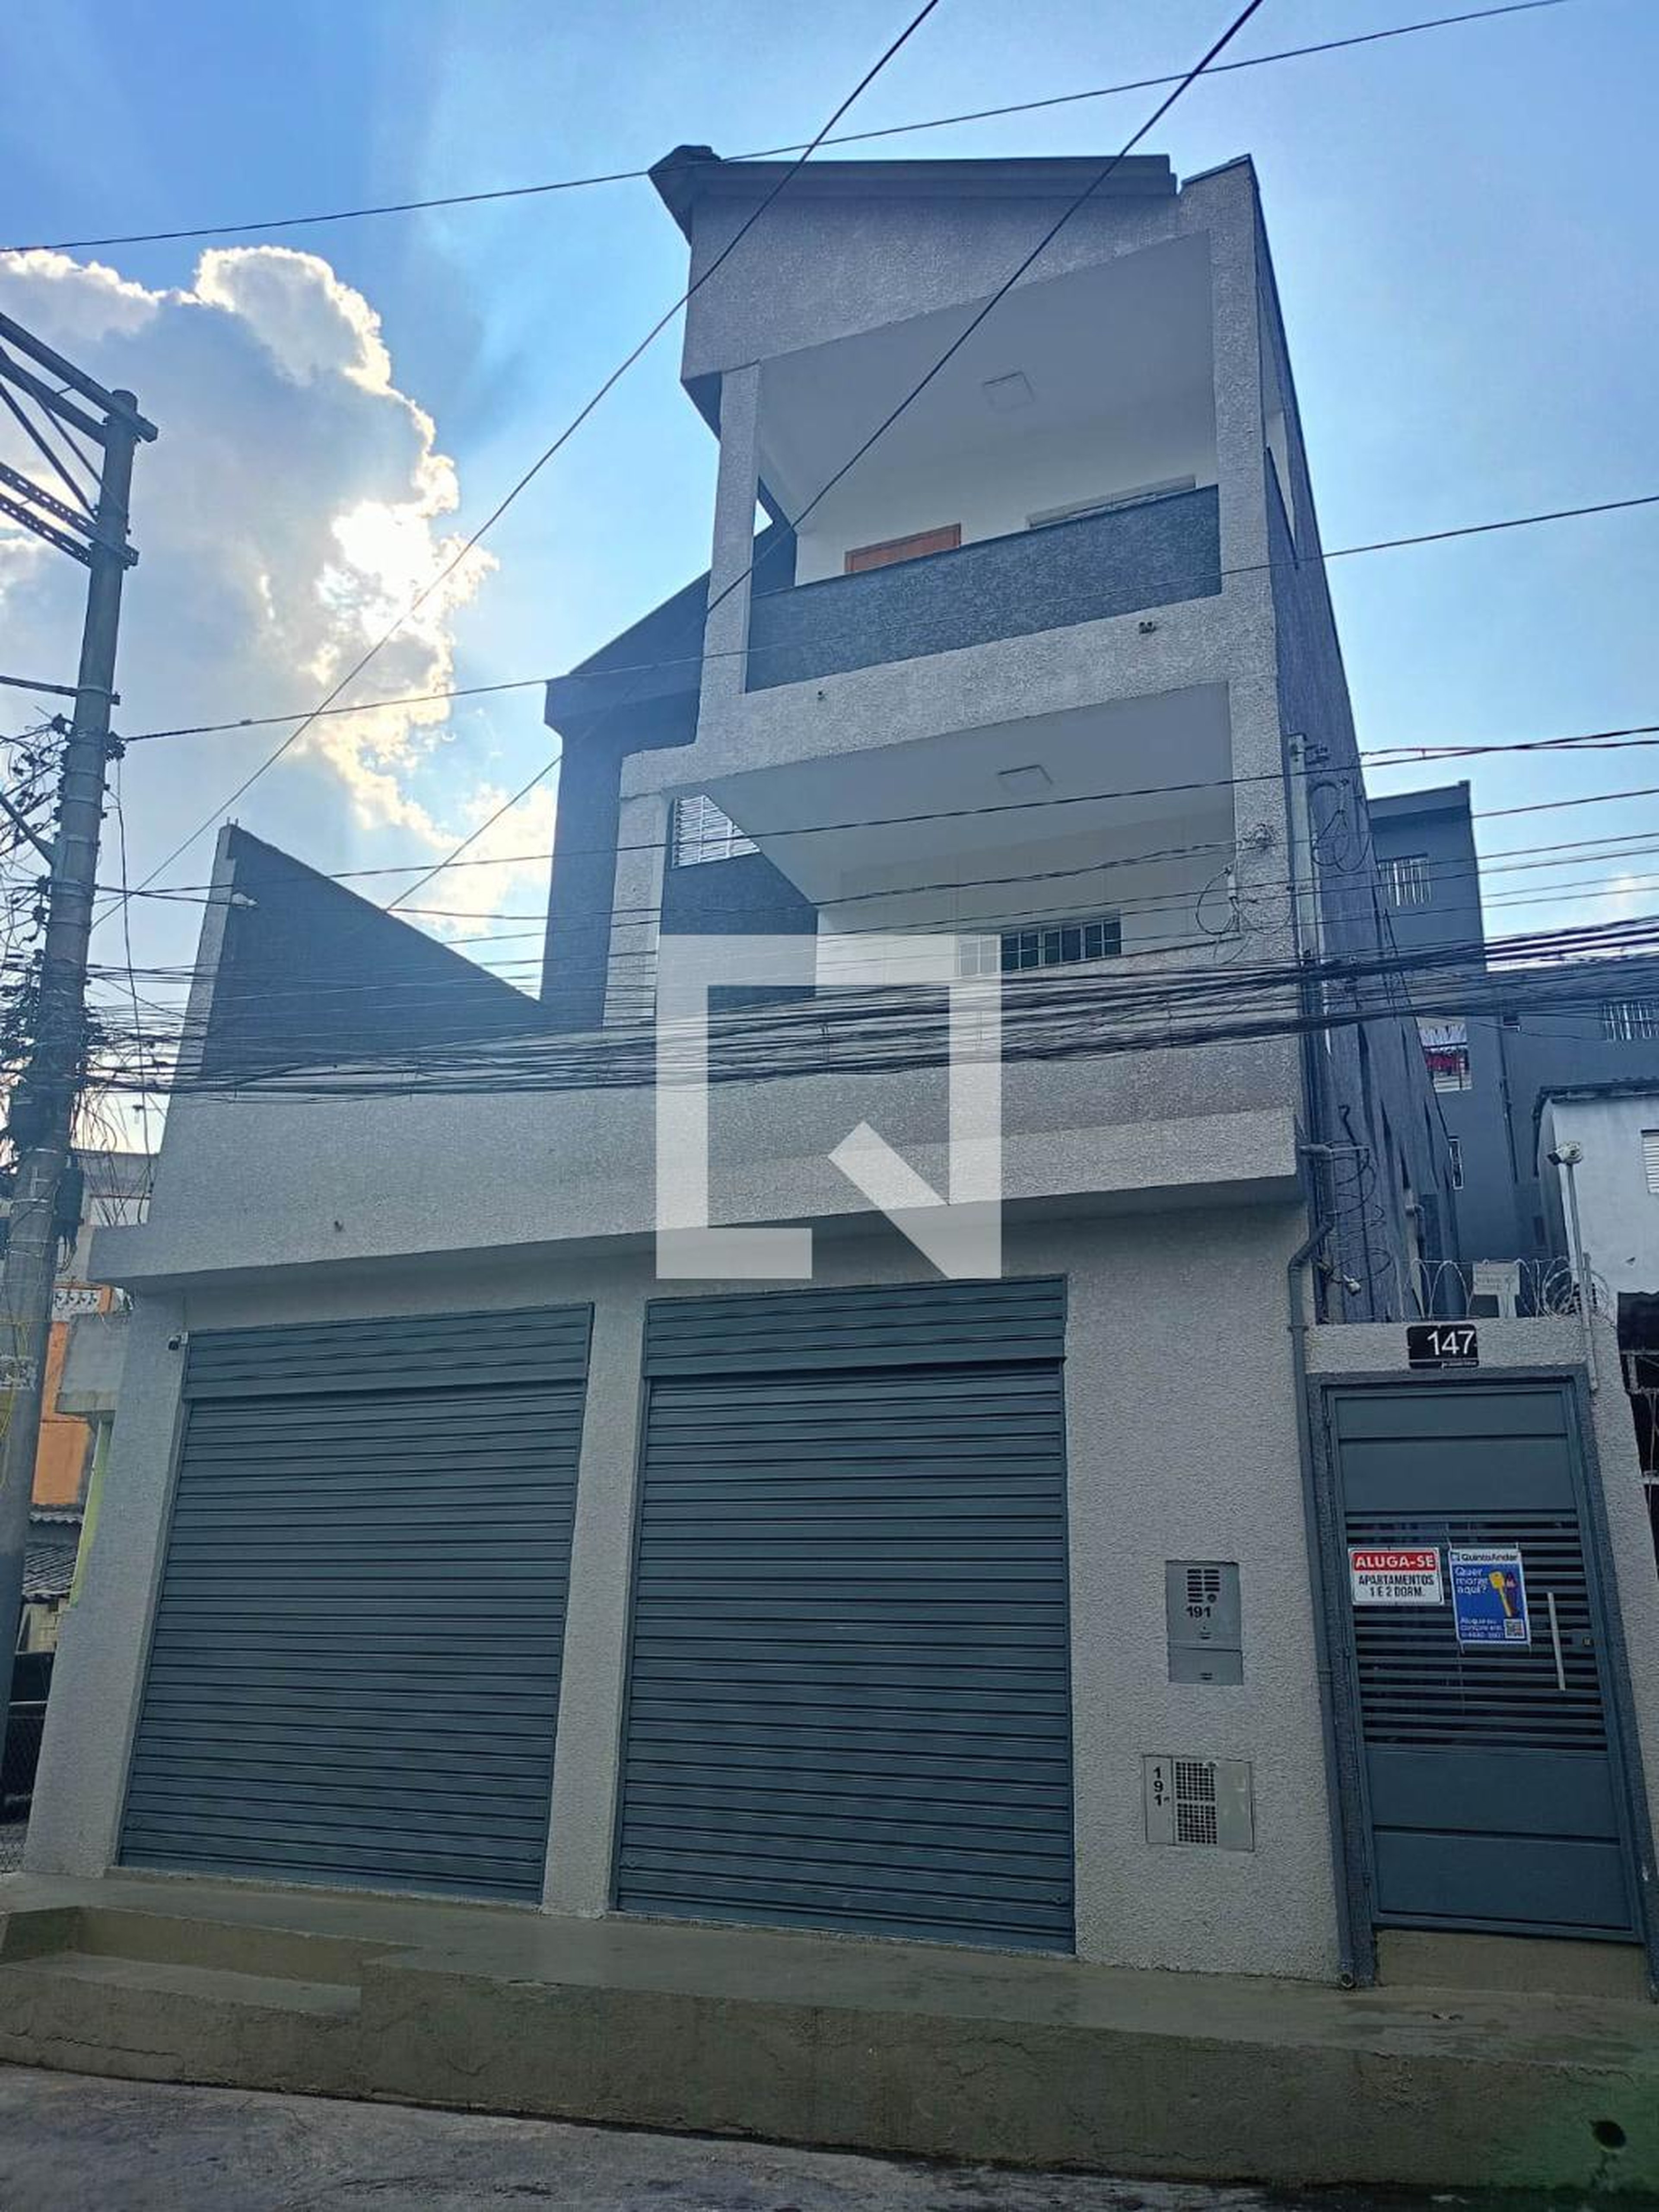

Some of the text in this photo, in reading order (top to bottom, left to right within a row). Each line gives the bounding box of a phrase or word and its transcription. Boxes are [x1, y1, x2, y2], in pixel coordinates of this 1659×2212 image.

[1427, 1330, 1475, 1356] 147
[1356, 1555, 1434, 1568] ALUGA-SE
[1359, 1574, 1435, 1585] APARTAMENTOS
[1370, 1586, 1425, 1597] 1 E 2 DORM.
[1457, 1584, 1487, 1595] aqui?
[1185, 1605, 1211, 1618] 191
